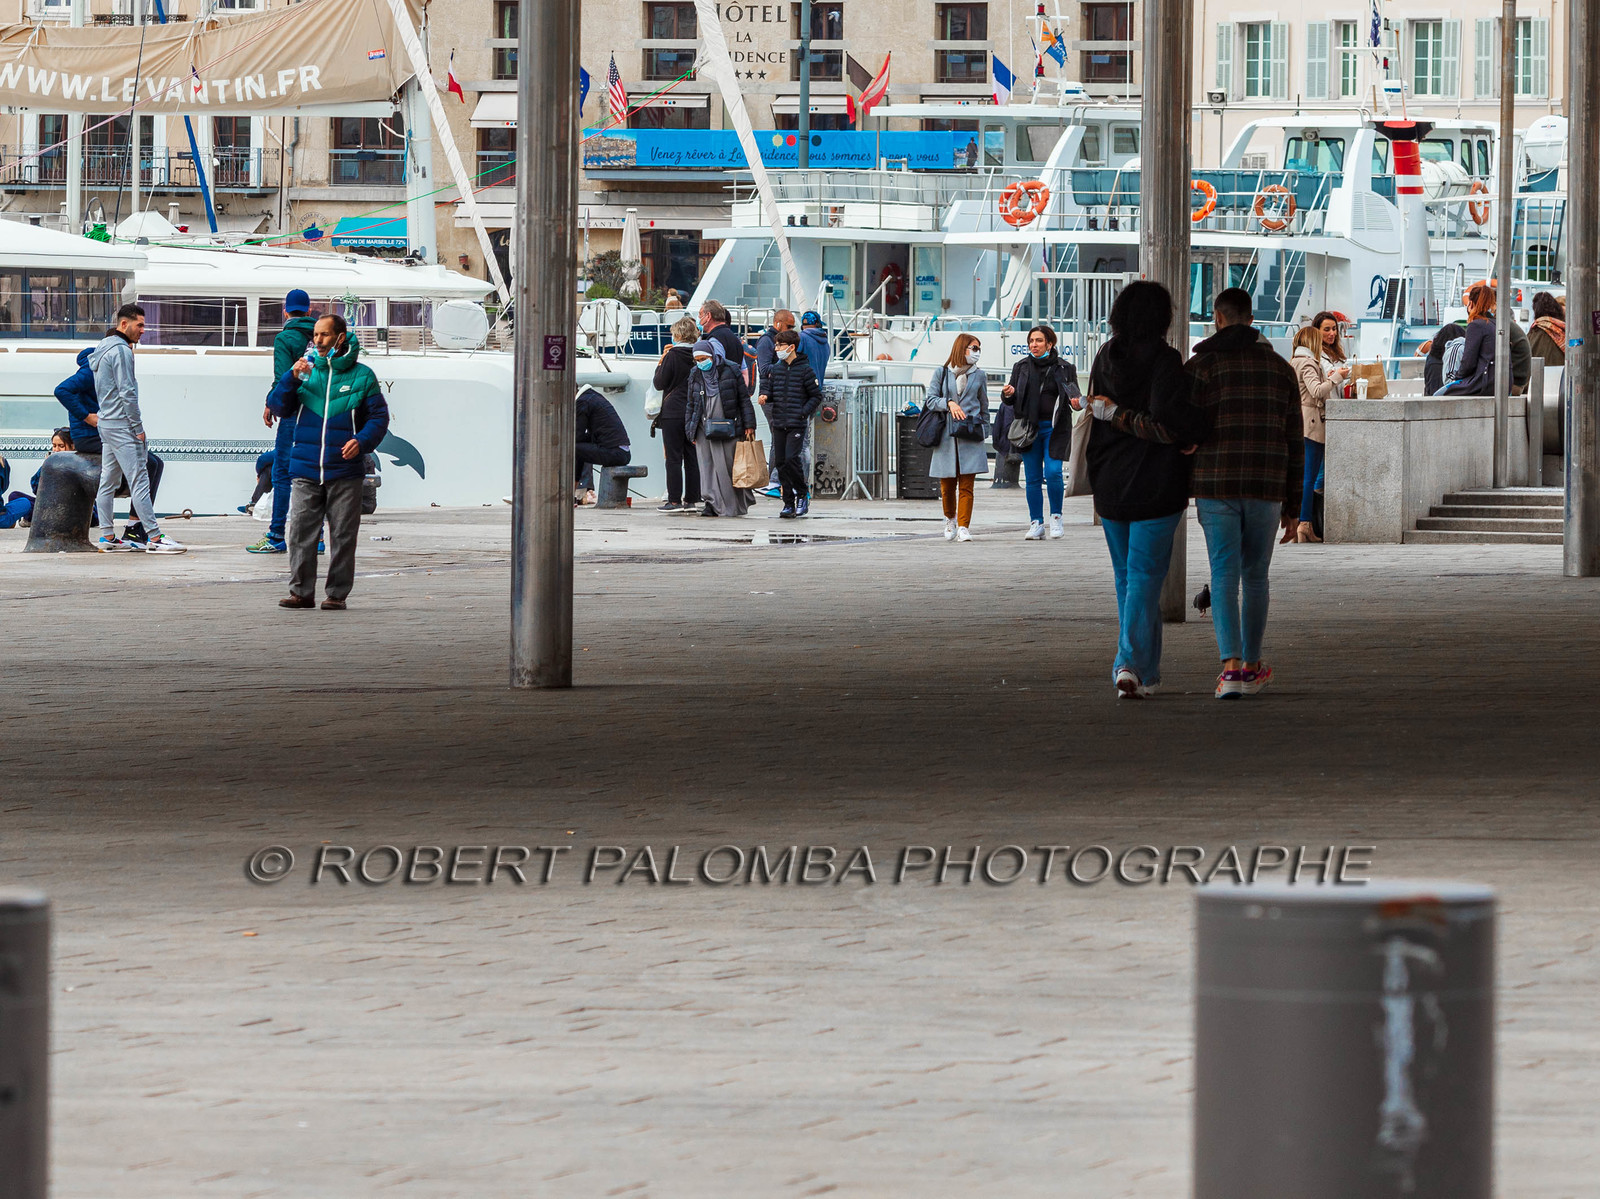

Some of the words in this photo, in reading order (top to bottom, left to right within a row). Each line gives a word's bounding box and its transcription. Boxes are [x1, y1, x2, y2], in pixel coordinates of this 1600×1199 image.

[736, 31, 752, 43] LA
[0, 64, 323, 104] WWW.LEVANTIN.FR
[650, 146, 682, 165] Venez
[684, 148, 716, 160] rêver
[718, 148, 727, 160] à
[727, 146, 744, 162] La
[809, 152, 827, 161] ous
[830, 152, 872, 161] sommes
[916, 153, 940, 162] vous
